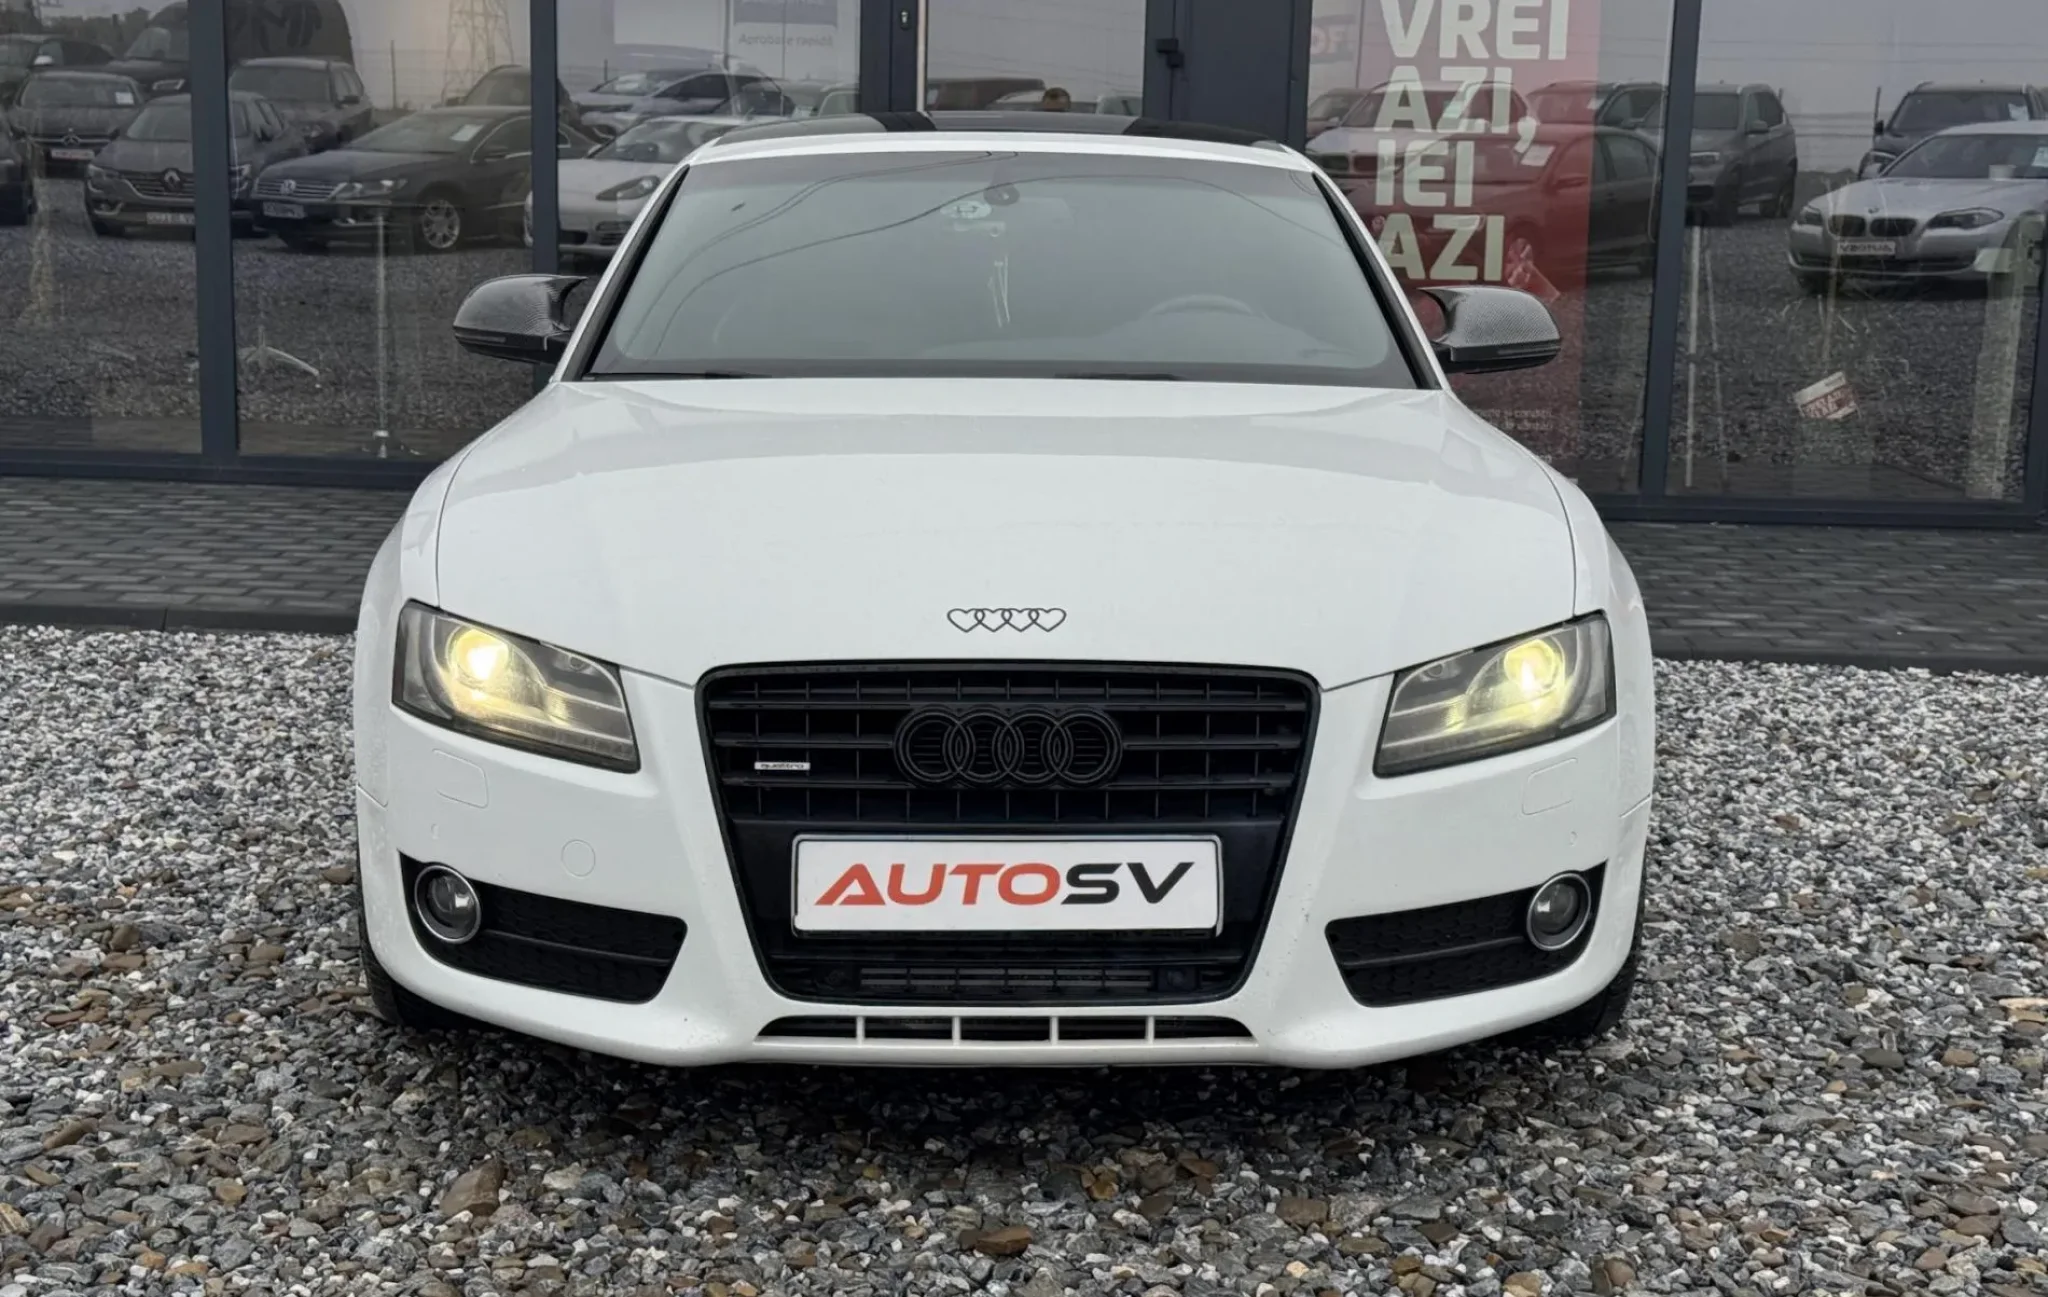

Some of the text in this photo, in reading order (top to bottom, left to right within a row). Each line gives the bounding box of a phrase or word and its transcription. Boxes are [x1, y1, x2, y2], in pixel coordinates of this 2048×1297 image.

[1380, 0, 1569, 60] VREI
[1373, 65, 1537, 154] AZI,
[1375, 139, 1475, 208] IEI
[1378, 213, 1505, 282] AZI
[814, 862, 1195, 906] AUTOSV
